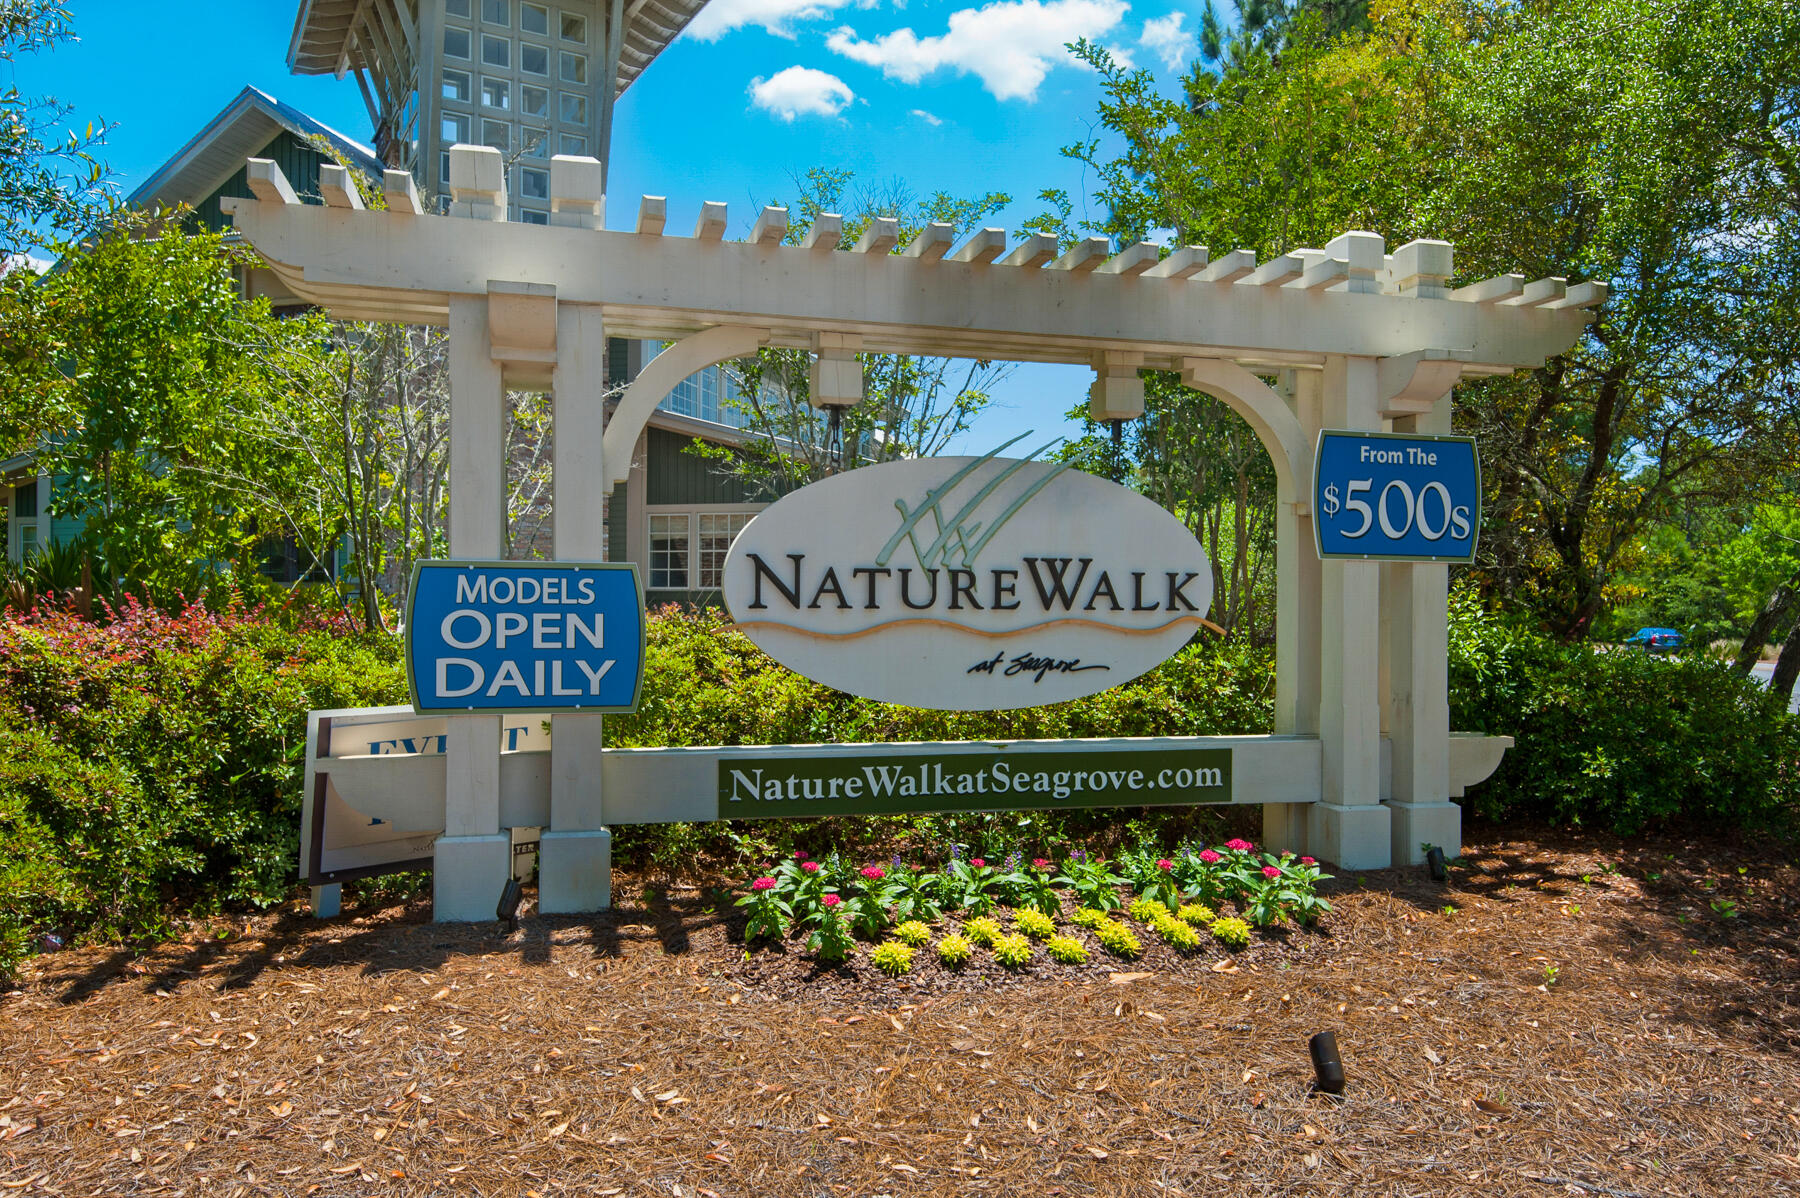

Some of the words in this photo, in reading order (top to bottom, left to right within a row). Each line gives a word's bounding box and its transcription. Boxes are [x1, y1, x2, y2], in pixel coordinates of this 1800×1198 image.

[1360, 446, 1403, 464] From
[1406, 447, 1438, 466] The
[455, 574, 596, 605] MODELS
[746, 553, 1199, 611] NATUREWALK
[440, 609, 605, 650] OPEN
[435, 657, 617, 698] DAILY
[967, 651, 1004, 675] at
[1004, 652, 1111, 683] Seagrove
[729, 762, 1224, 803] NatureWalkatSeagrove.com
